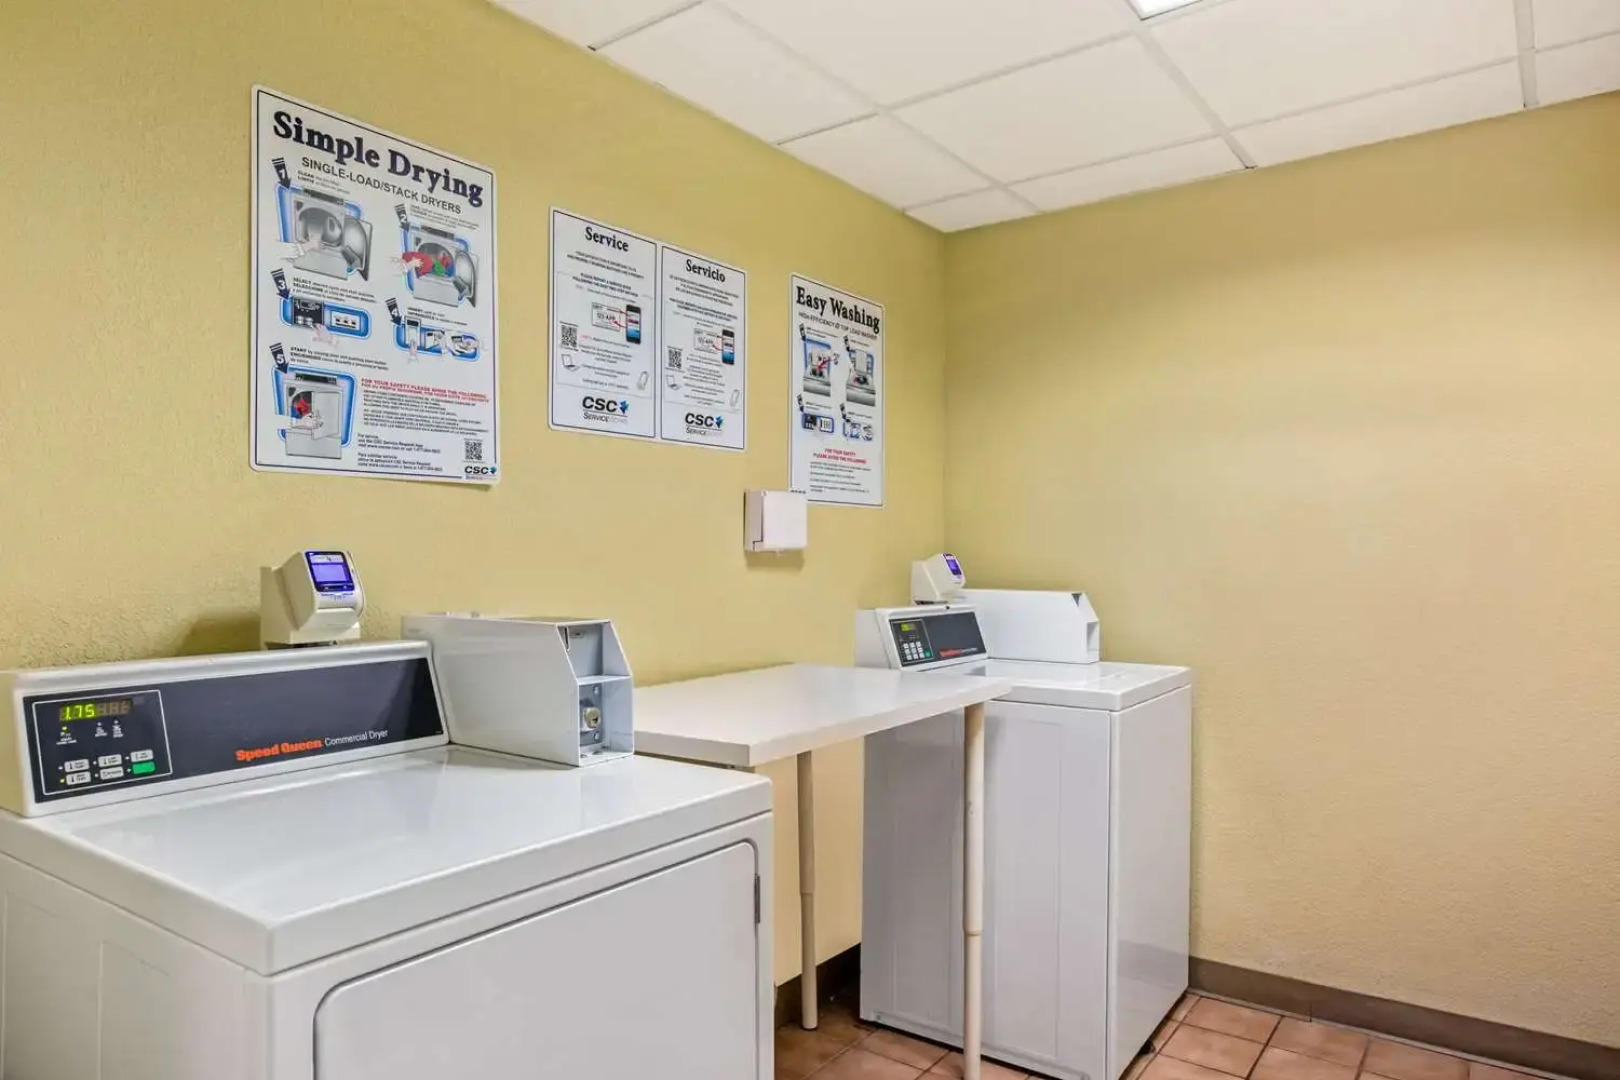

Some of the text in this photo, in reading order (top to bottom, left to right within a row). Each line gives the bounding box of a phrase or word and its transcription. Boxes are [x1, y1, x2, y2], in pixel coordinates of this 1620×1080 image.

[273, 111, 484, 208] Simple Drying
[302, 157, 419, 202] SINGLE-LOAD/STACK
[421, 195, 462, 215] DRYERS
[585, 226, 629, 252] Service
[685, 259, 726, 283] Servicio
[278, 279, 287, 291] 3
[796, 285, 880, 334] Easy Washing
[276, 354, 286, 365] 5
[582, 396, 618, 413] CSC
[685, 412, 714, 427] CSC
[464, 465, 489, 475] CSC
[65, 703, 96, 721] 1.75
[235, 728, 390, 763] Speed Queen Commercial Dryer
